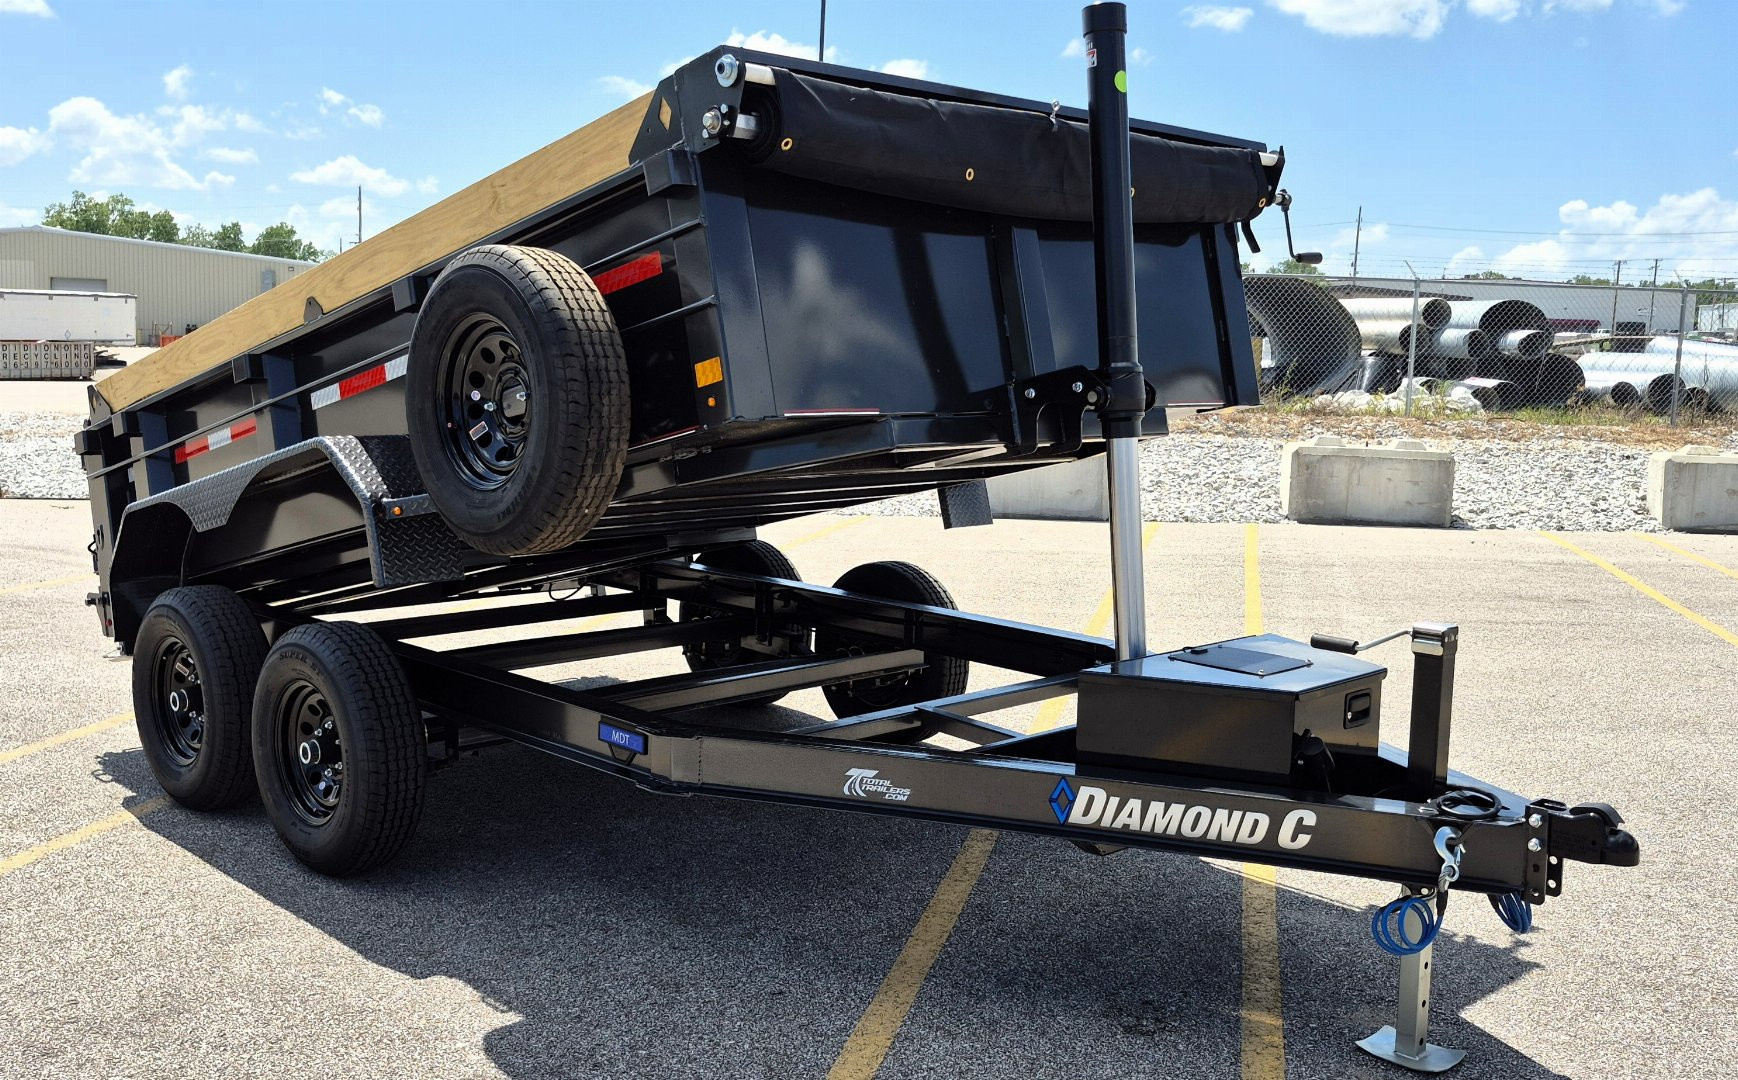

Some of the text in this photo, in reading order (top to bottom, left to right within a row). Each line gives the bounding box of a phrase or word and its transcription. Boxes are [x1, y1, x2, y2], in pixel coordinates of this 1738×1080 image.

[2, 344, 59, 352] DIDION
[611, 729, 630, 746] MDT
[861, 777, 893, 787] TOTAL
[861, 784, 911, 796] TRAILERS
[882, 793, 909, 802] .COM
[1067, 785, 1318, 850] DIAMOND C
